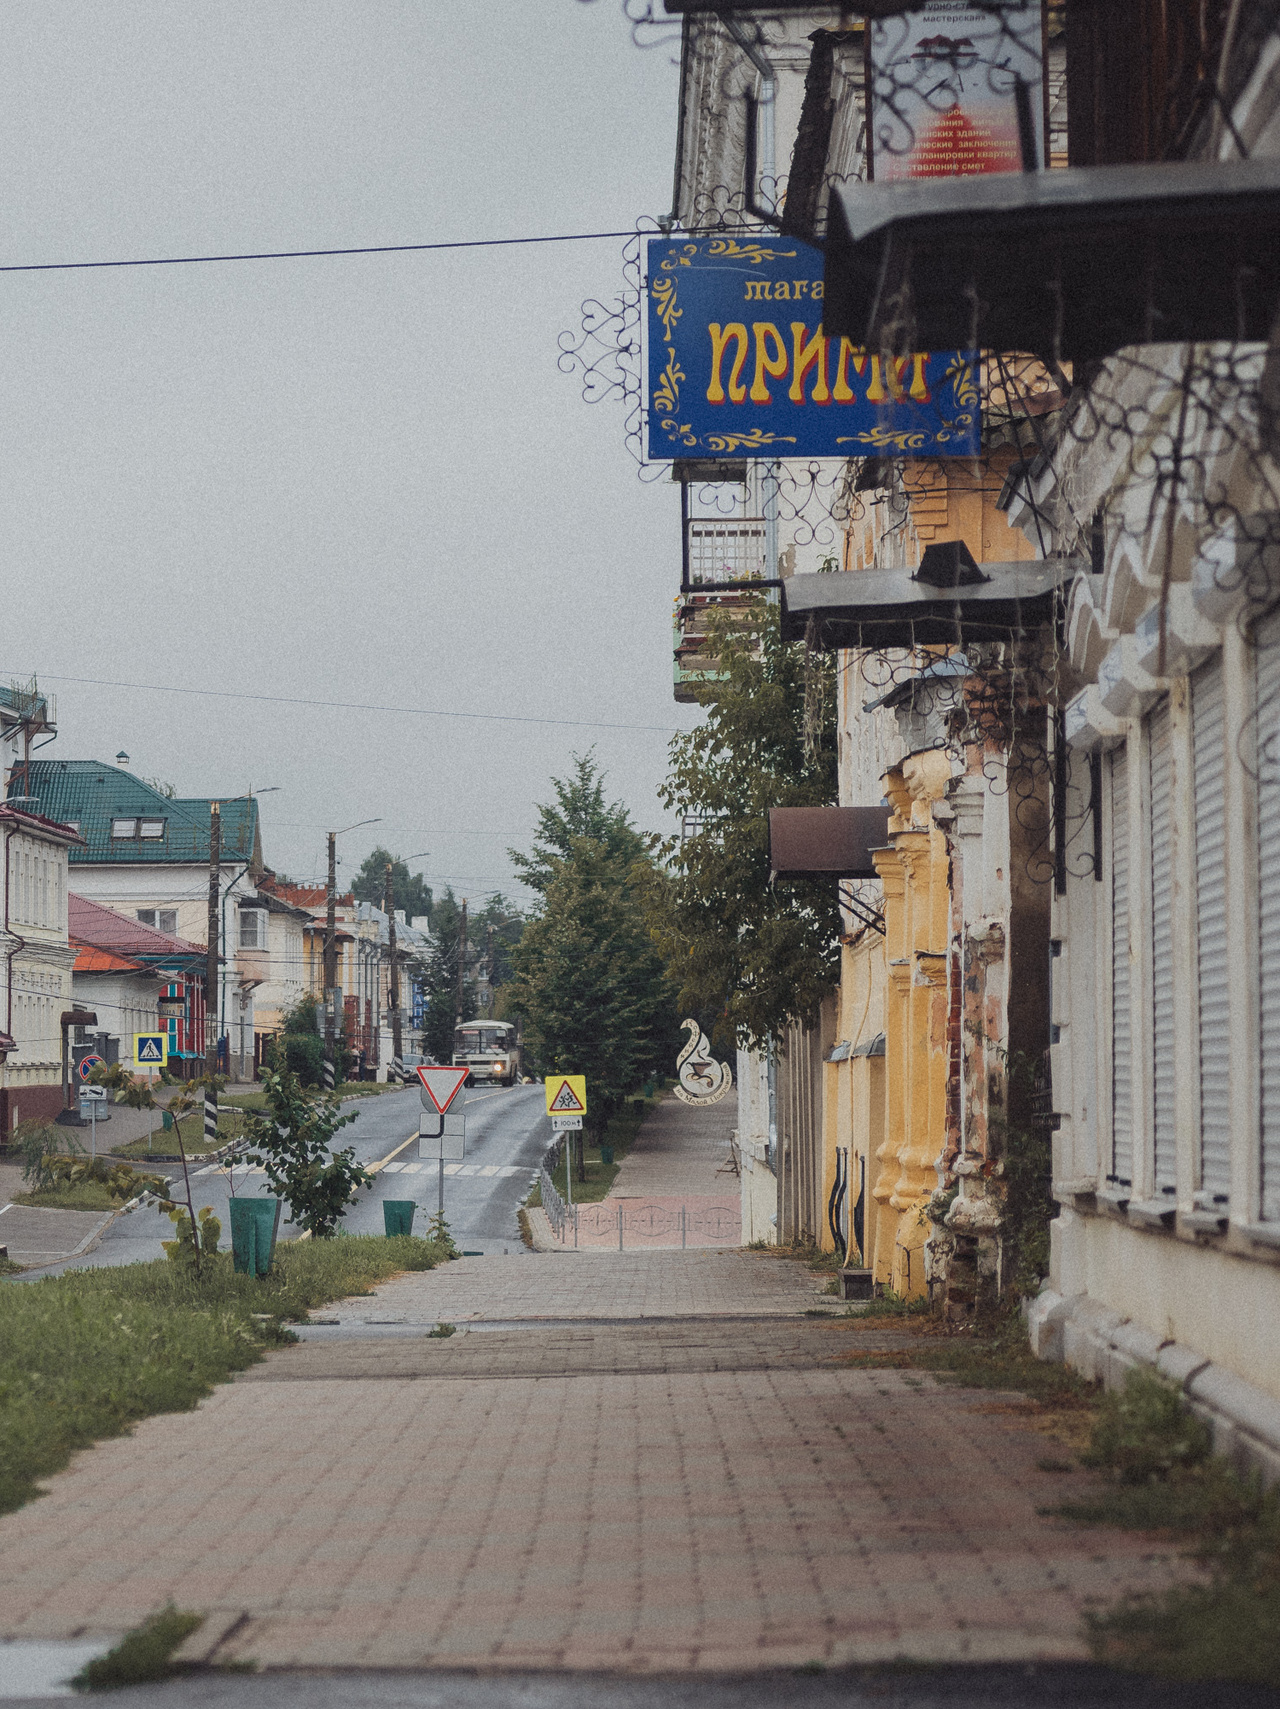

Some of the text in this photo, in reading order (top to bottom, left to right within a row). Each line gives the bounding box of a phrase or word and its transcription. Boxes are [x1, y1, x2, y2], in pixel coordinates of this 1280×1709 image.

[918, 129, 954, 138] анских
[914, 138, 1018, 149] ические заключения
[977, 150, 1018, 160] квартир
[961, 161, 986, 170] смет
[744, 280, 825, 300] мага
